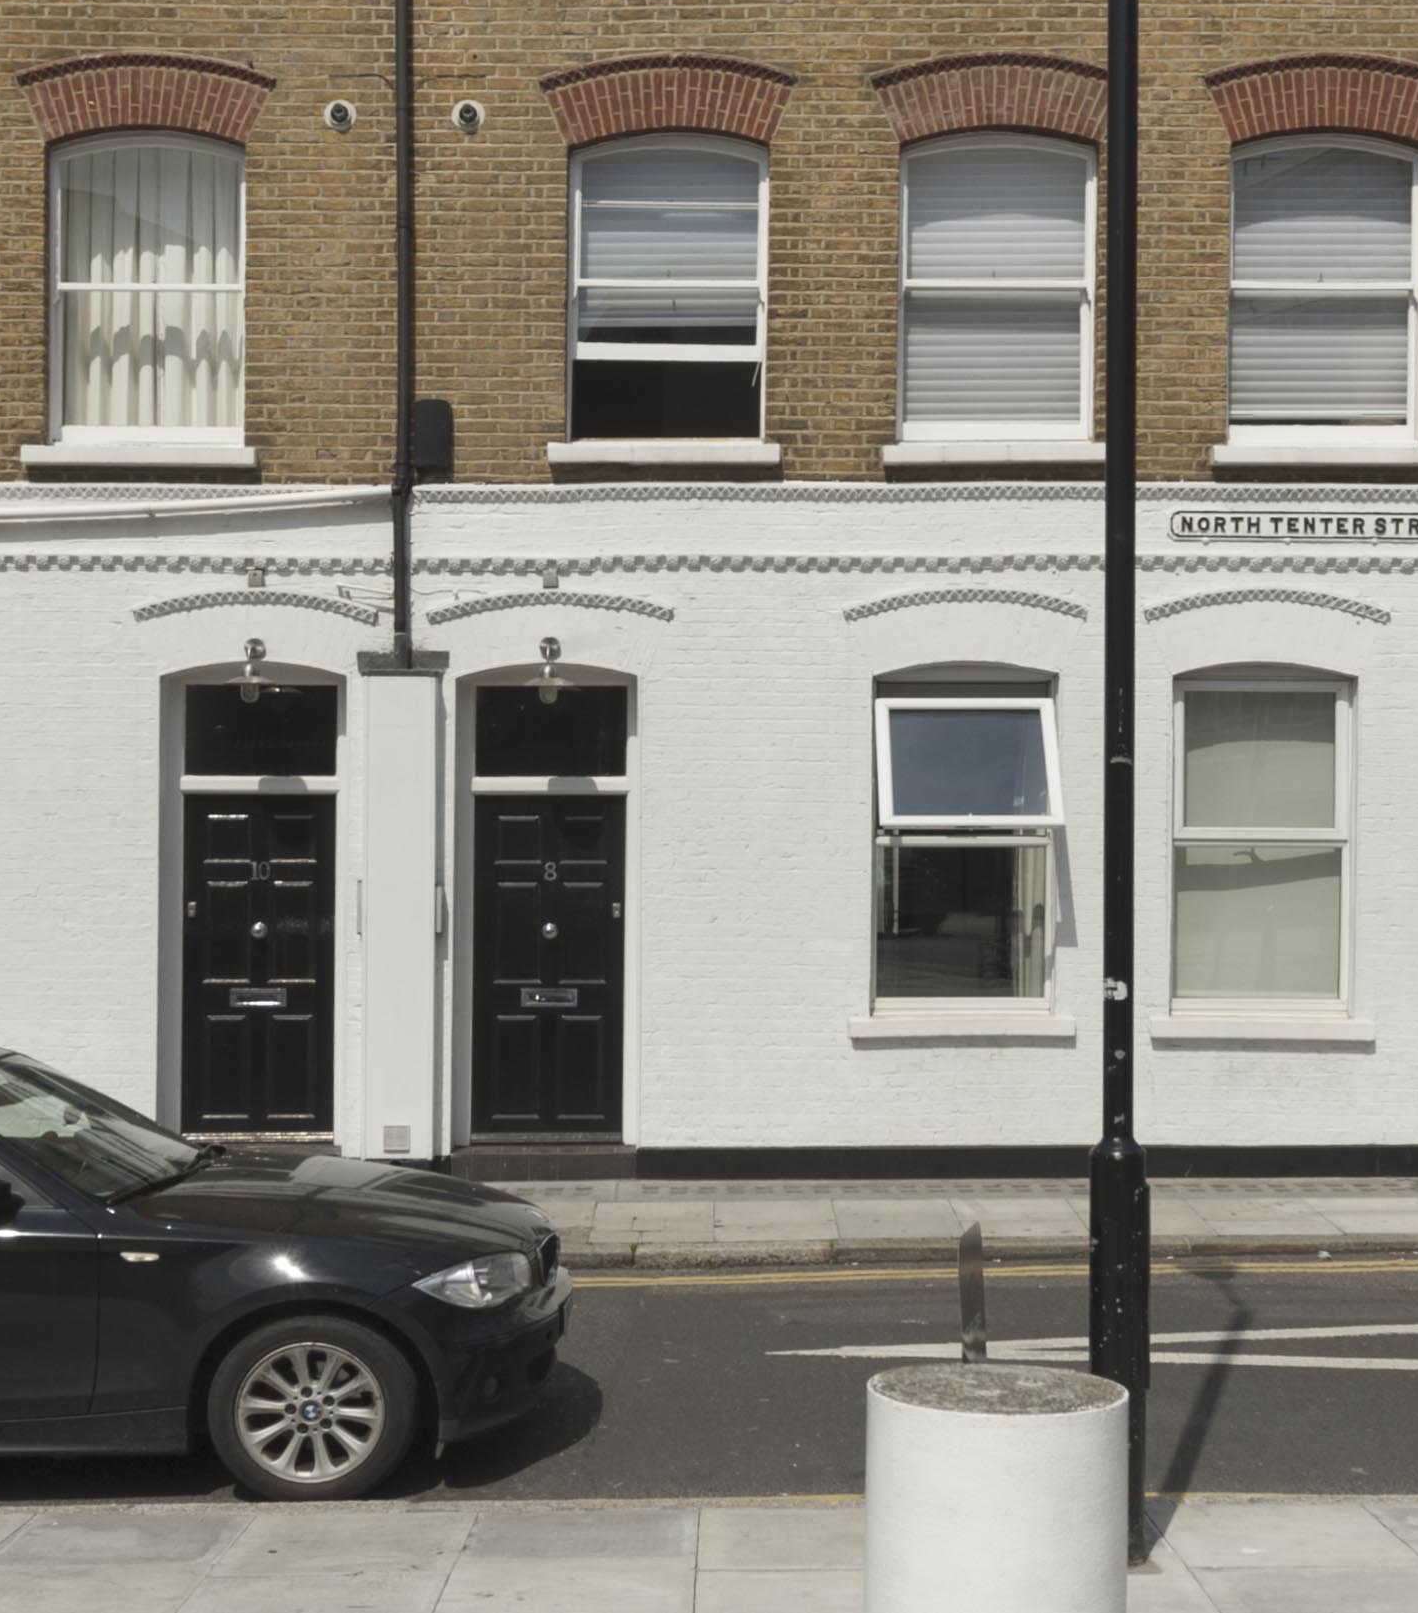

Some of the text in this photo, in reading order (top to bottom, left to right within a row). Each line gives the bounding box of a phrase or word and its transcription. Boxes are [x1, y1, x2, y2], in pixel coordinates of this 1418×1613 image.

[1181, 516, 1261, 534] NORTH
[1270, 516, 1366, 535] TENTER
[250, 861, 271, 880] 10
[543, 862, 557, 881] 8
